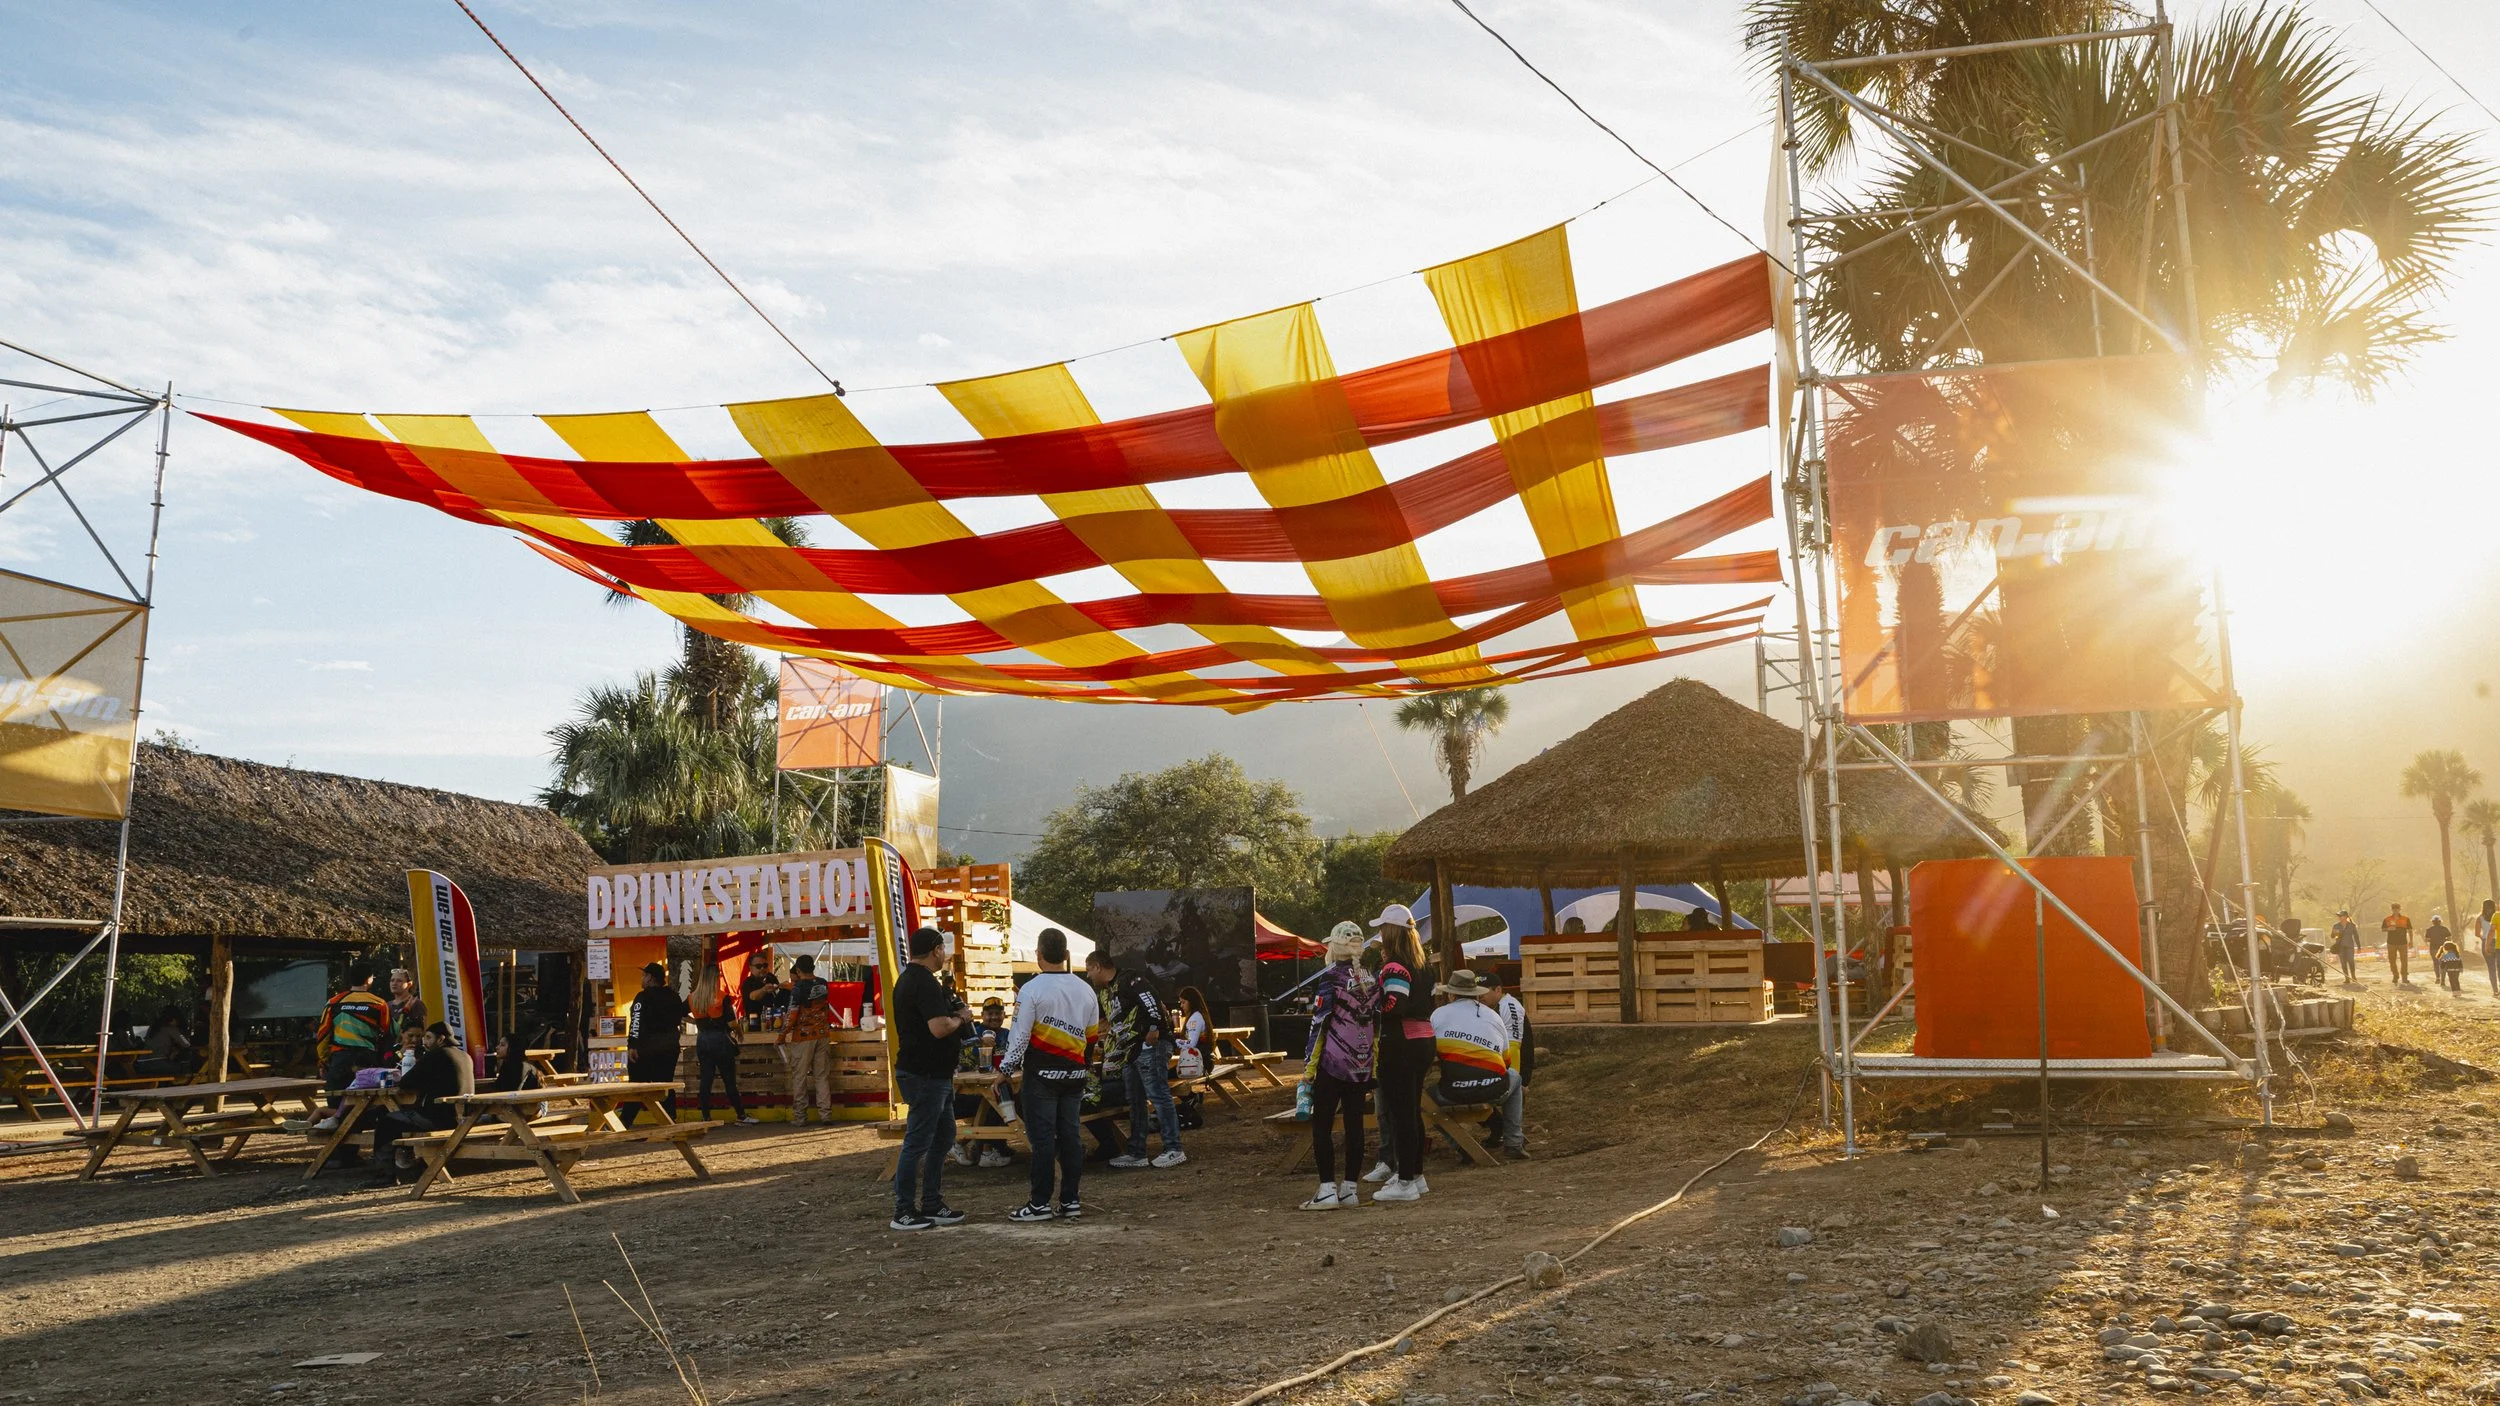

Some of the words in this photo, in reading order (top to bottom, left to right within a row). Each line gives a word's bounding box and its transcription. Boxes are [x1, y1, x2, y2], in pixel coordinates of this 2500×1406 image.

[0, 677, 120, 720] n-am
[785, 702, 873, 720] can-am
[435, 884, 452, 954] can-am
[443, 960, 461, 1029] can-am
[1042, 1015, 1068, 1031] GRUPO
[1444, 1030, 1472, 1042] GRUPO
[1473, 1036, 1492, 1049] RISE
[590, 1052, 628, 1070] CAN-A
